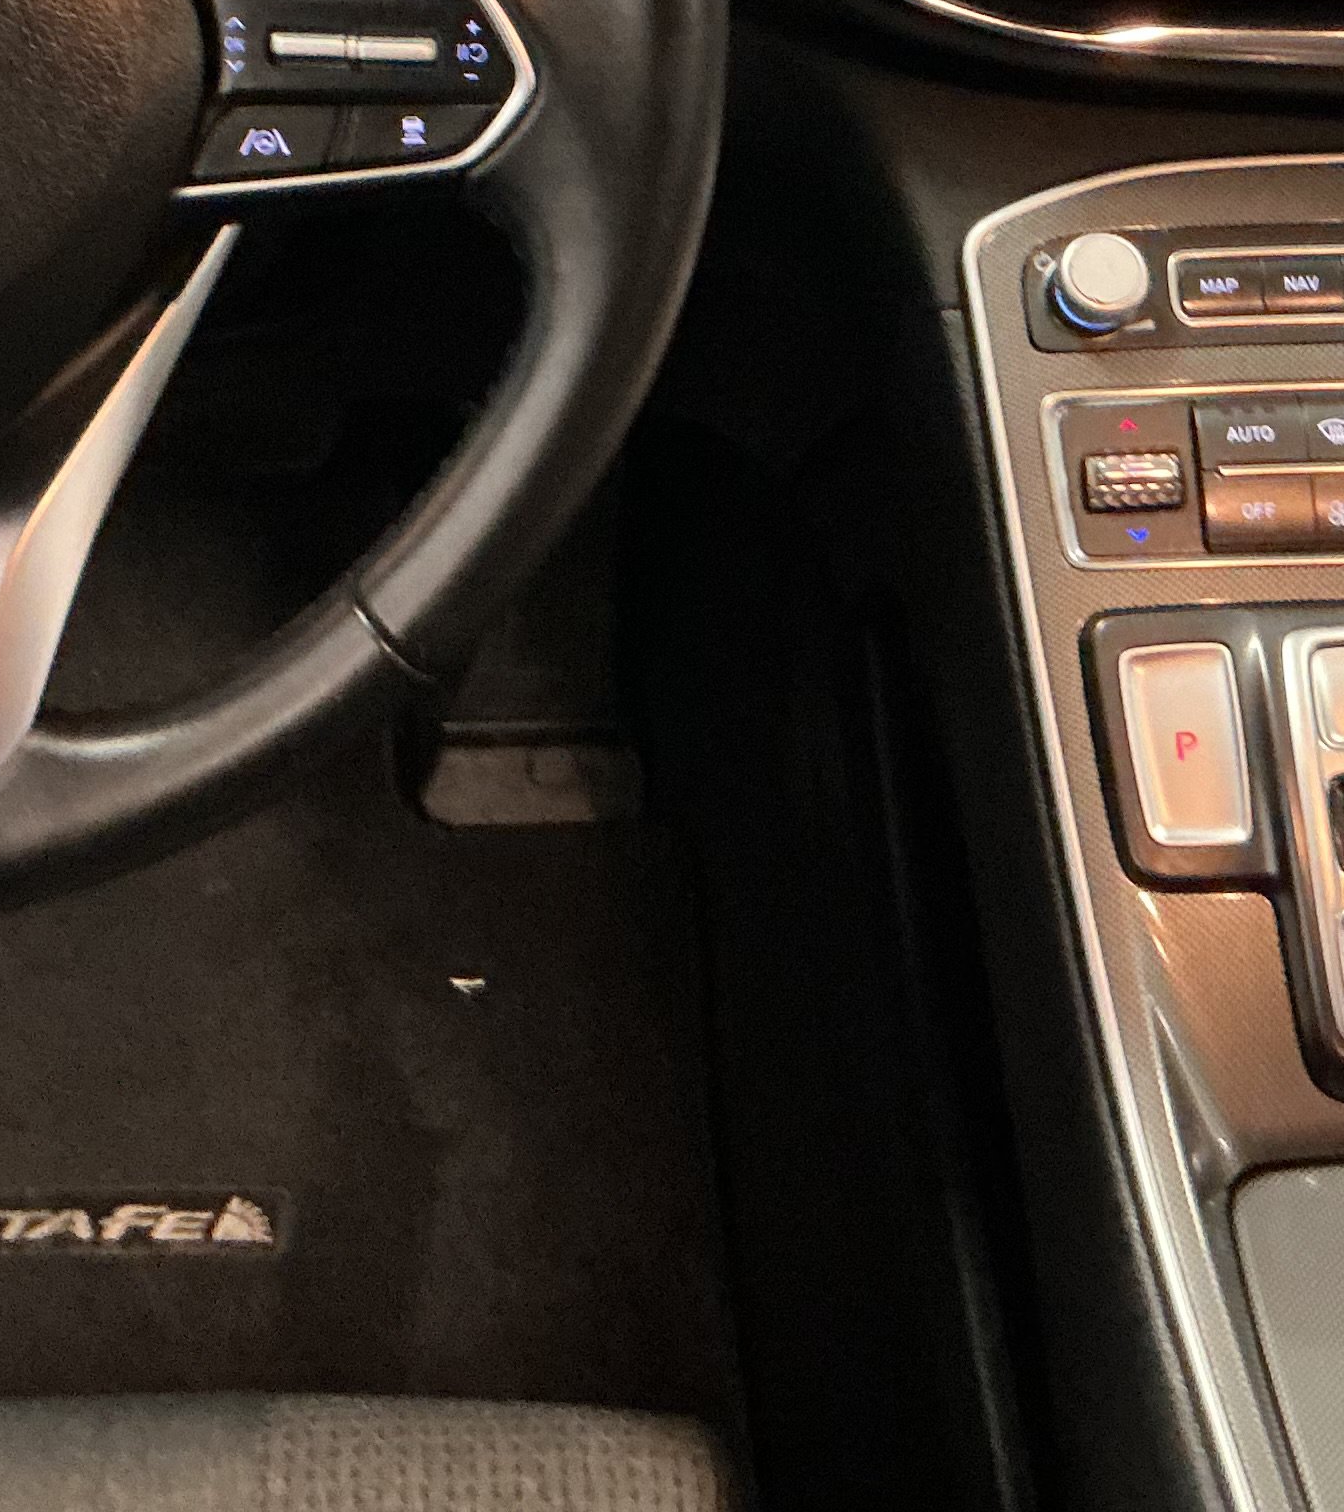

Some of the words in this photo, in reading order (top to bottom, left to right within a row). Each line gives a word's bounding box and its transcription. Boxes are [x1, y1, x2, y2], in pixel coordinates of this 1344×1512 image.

[1283, 274, 1321, 293] NAV
[1226, 424, 1277, 444] AUTO
[1241, 501, 1278, 521] OFF
[1174, 731, 1199, 761] P
[99, 1204, 214, 1242] FE
